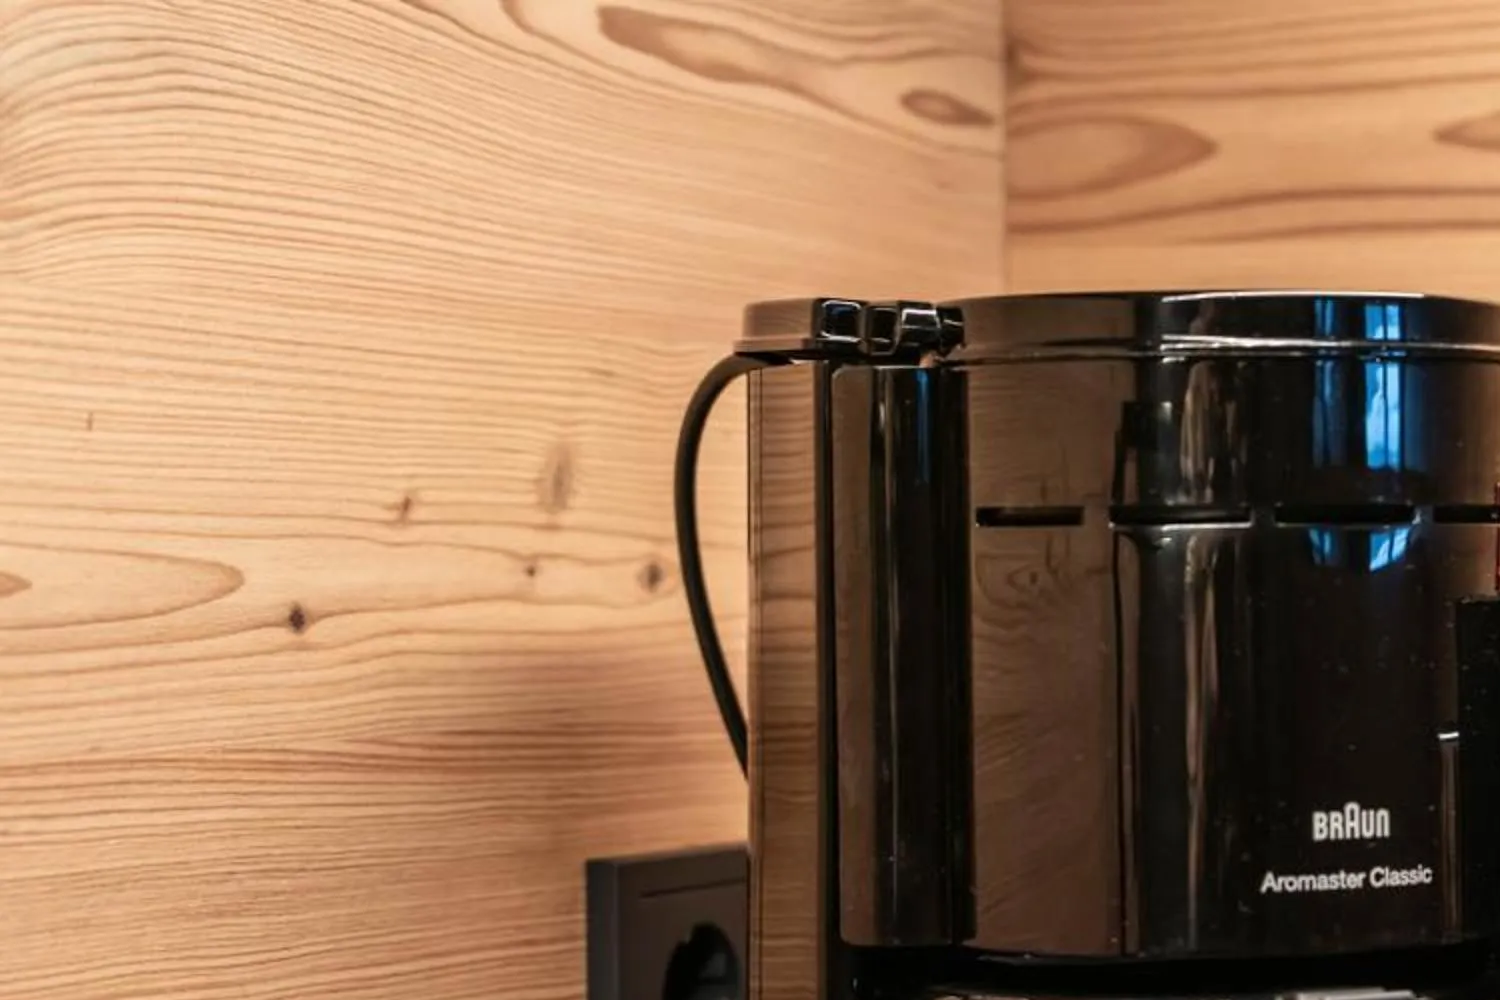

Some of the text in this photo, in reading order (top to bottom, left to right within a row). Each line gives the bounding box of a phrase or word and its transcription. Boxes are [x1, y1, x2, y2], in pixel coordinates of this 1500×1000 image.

[1312, 801, 1391, 842] BRAUN
[1260, 864, 1433, 893] Aromaster Classic
